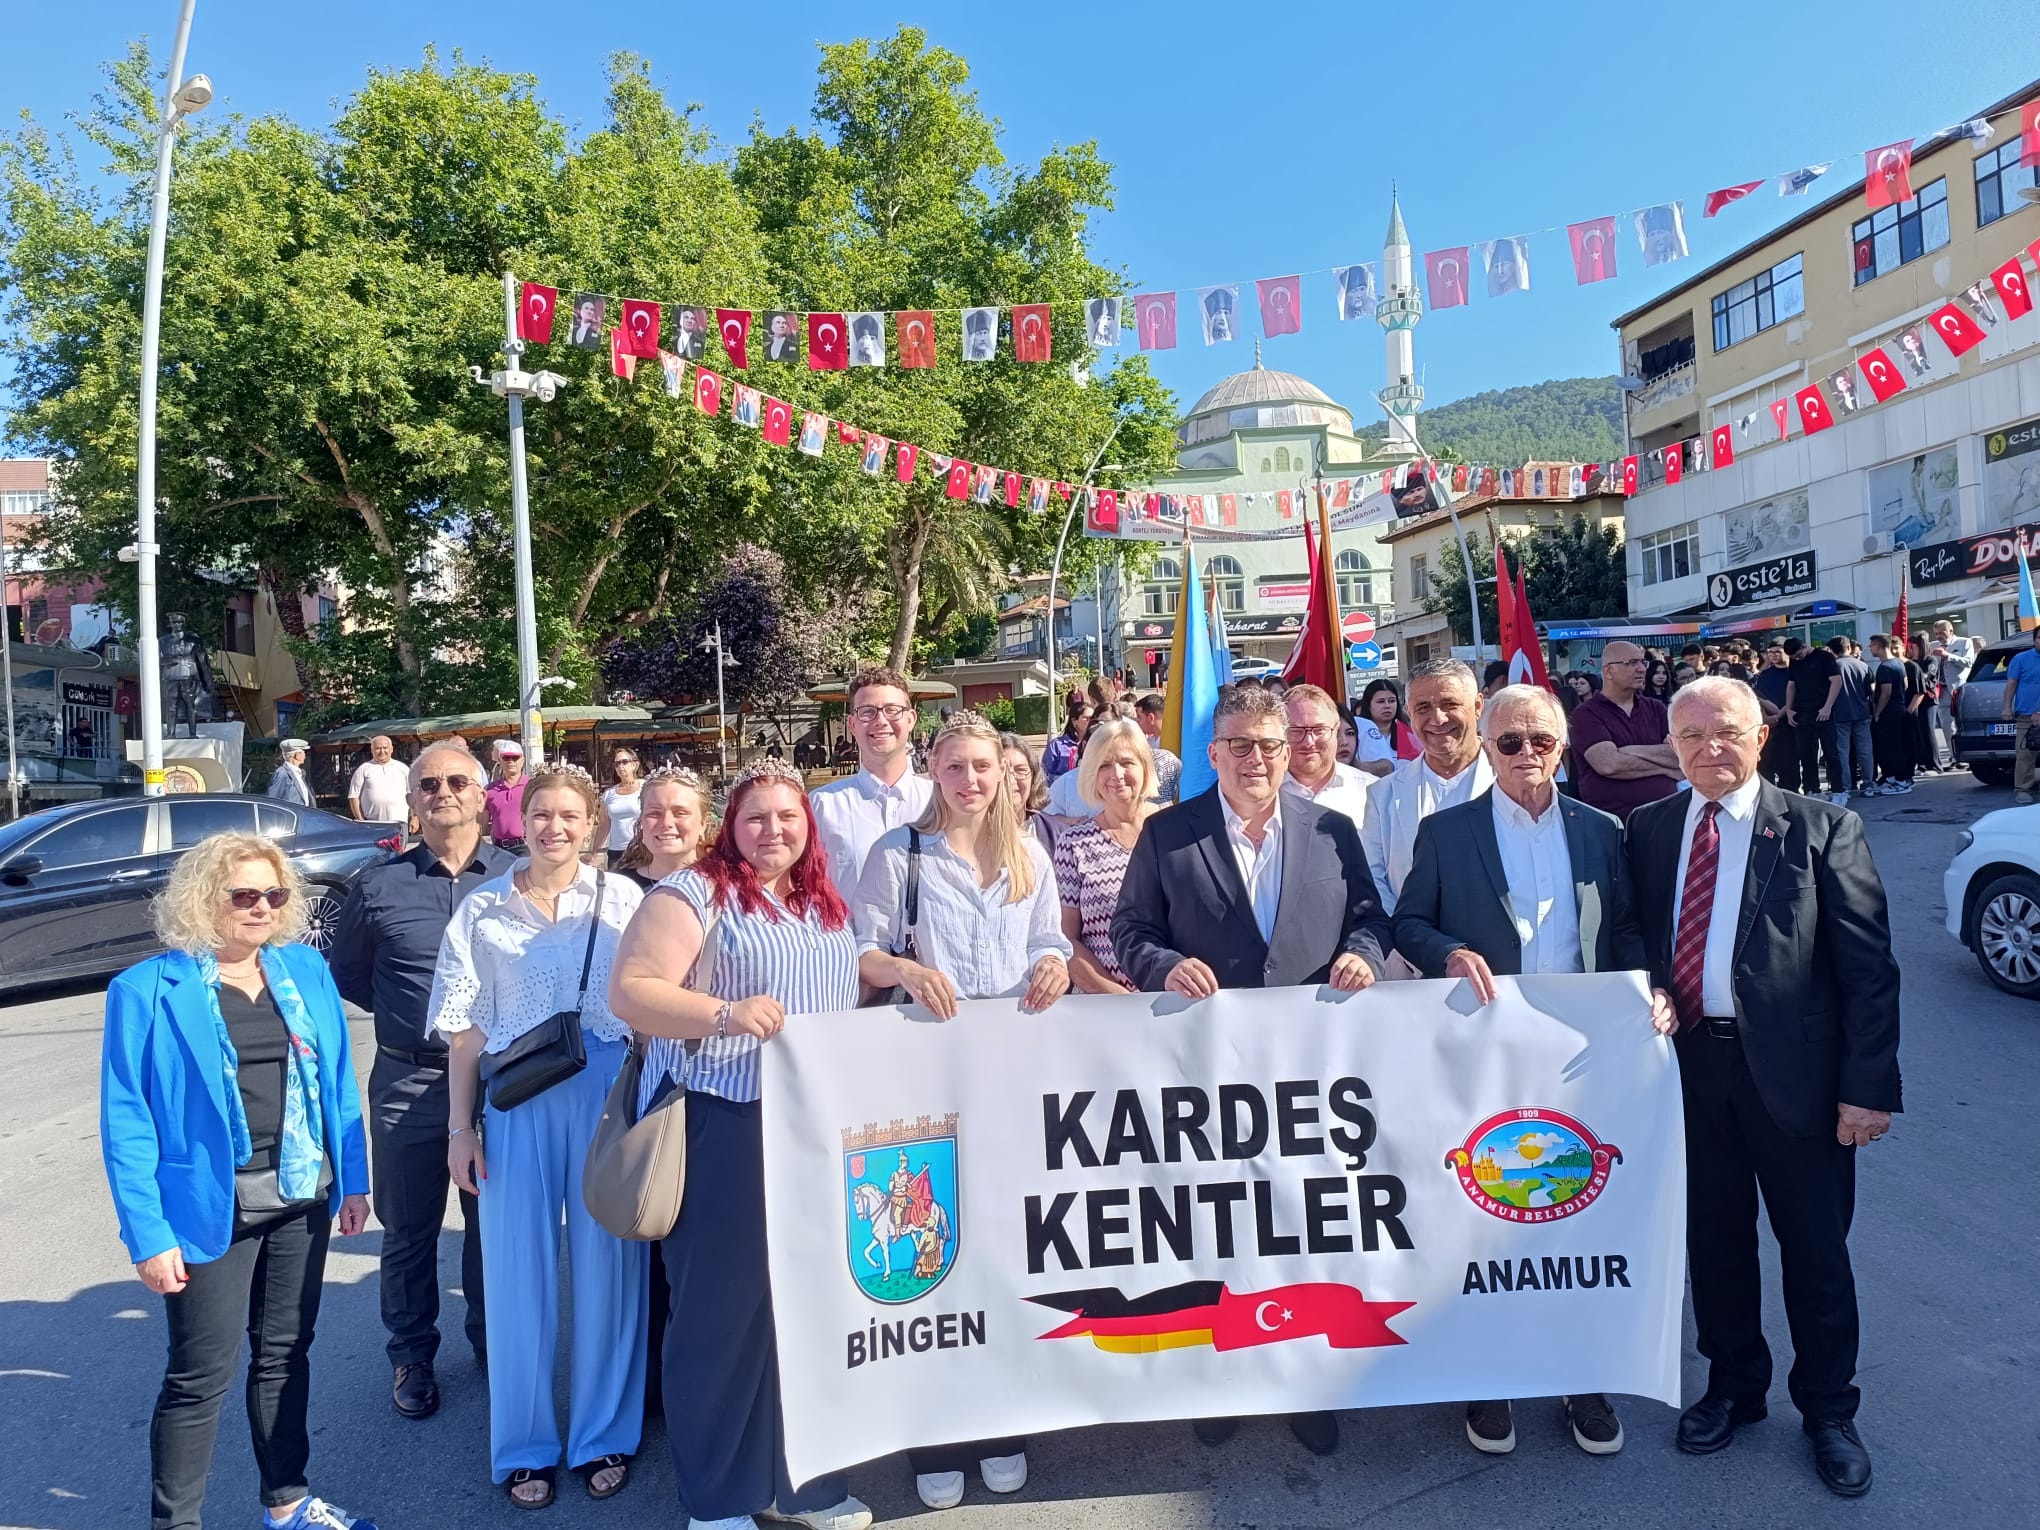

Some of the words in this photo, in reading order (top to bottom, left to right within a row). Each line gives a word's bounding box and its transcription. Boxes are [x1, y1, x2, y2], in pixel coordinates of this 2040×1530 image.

[2009, 426, 2040, 445] est
[1915, 549, 1955, 579] Ray-Ban
[1043, 1077, 1377, 1170] KARDEŞ
[1517, 1109, 1539, 1118] 1909
[1462, 1176, 1519, 1220] ANAMUR
[1524, 1171, 1607, 1221] BELEDİYESİ
[1024, 1174, 1415, 1274] KENTLER
[1462, 1255, 1631, 1295] ANAMUR
[847, 1311, 986, 1369] BİNGEN
